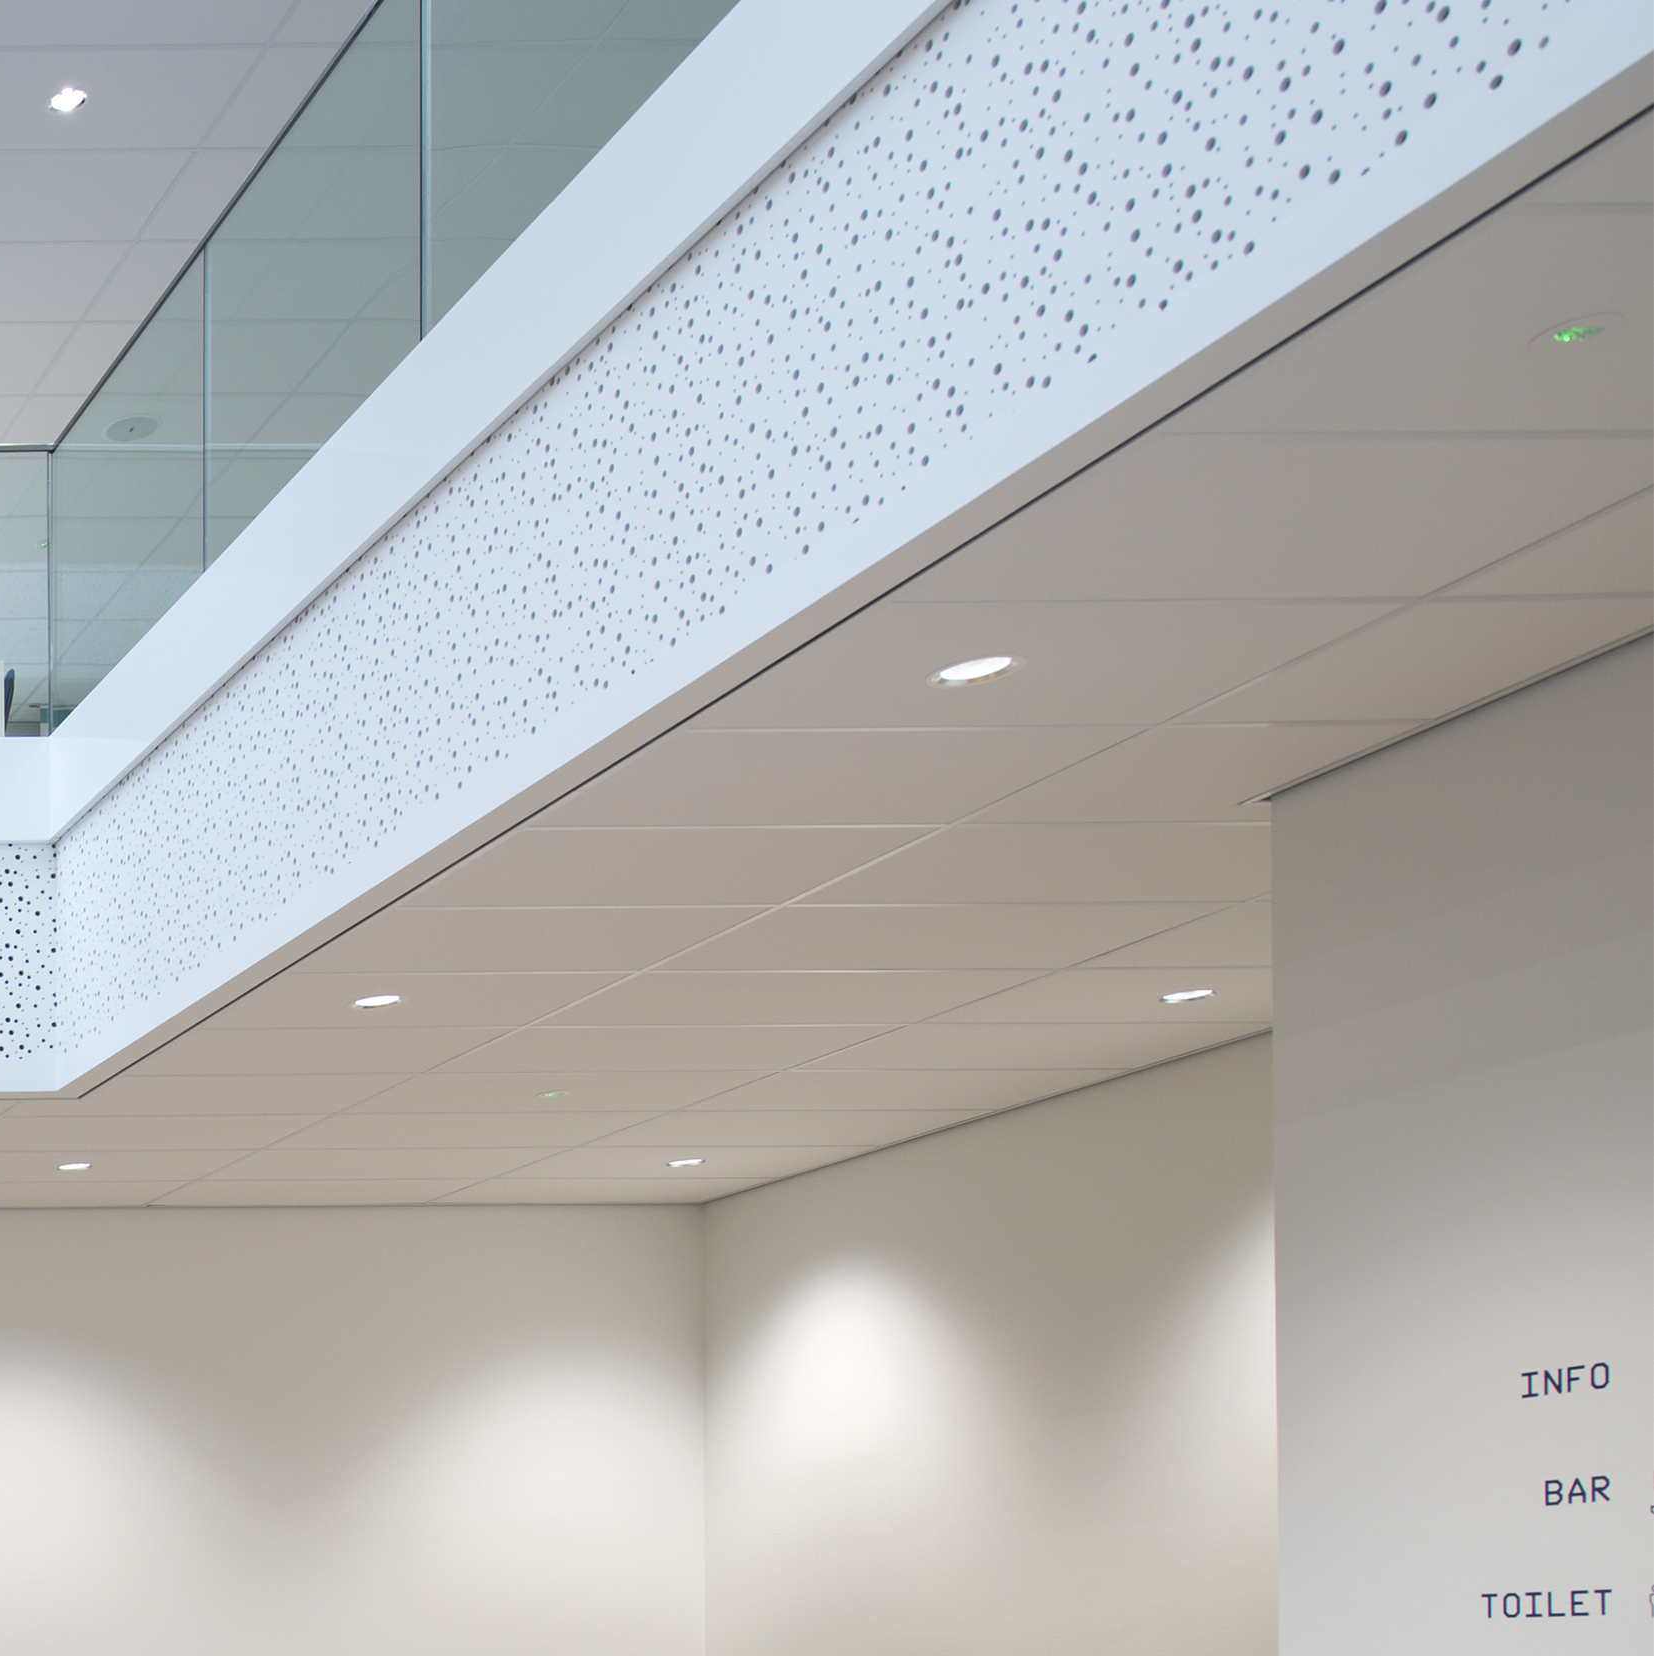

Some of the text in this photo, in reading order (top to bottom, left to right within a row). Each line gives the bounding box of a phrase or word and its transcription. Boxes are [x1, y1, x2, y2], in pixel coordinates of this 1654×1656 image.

[1521, 1362, 1611, 1399] INFO
[1544, 1475, 1611, 1506] BAR
[1481, 1589, 1613, 1619] TOILET
